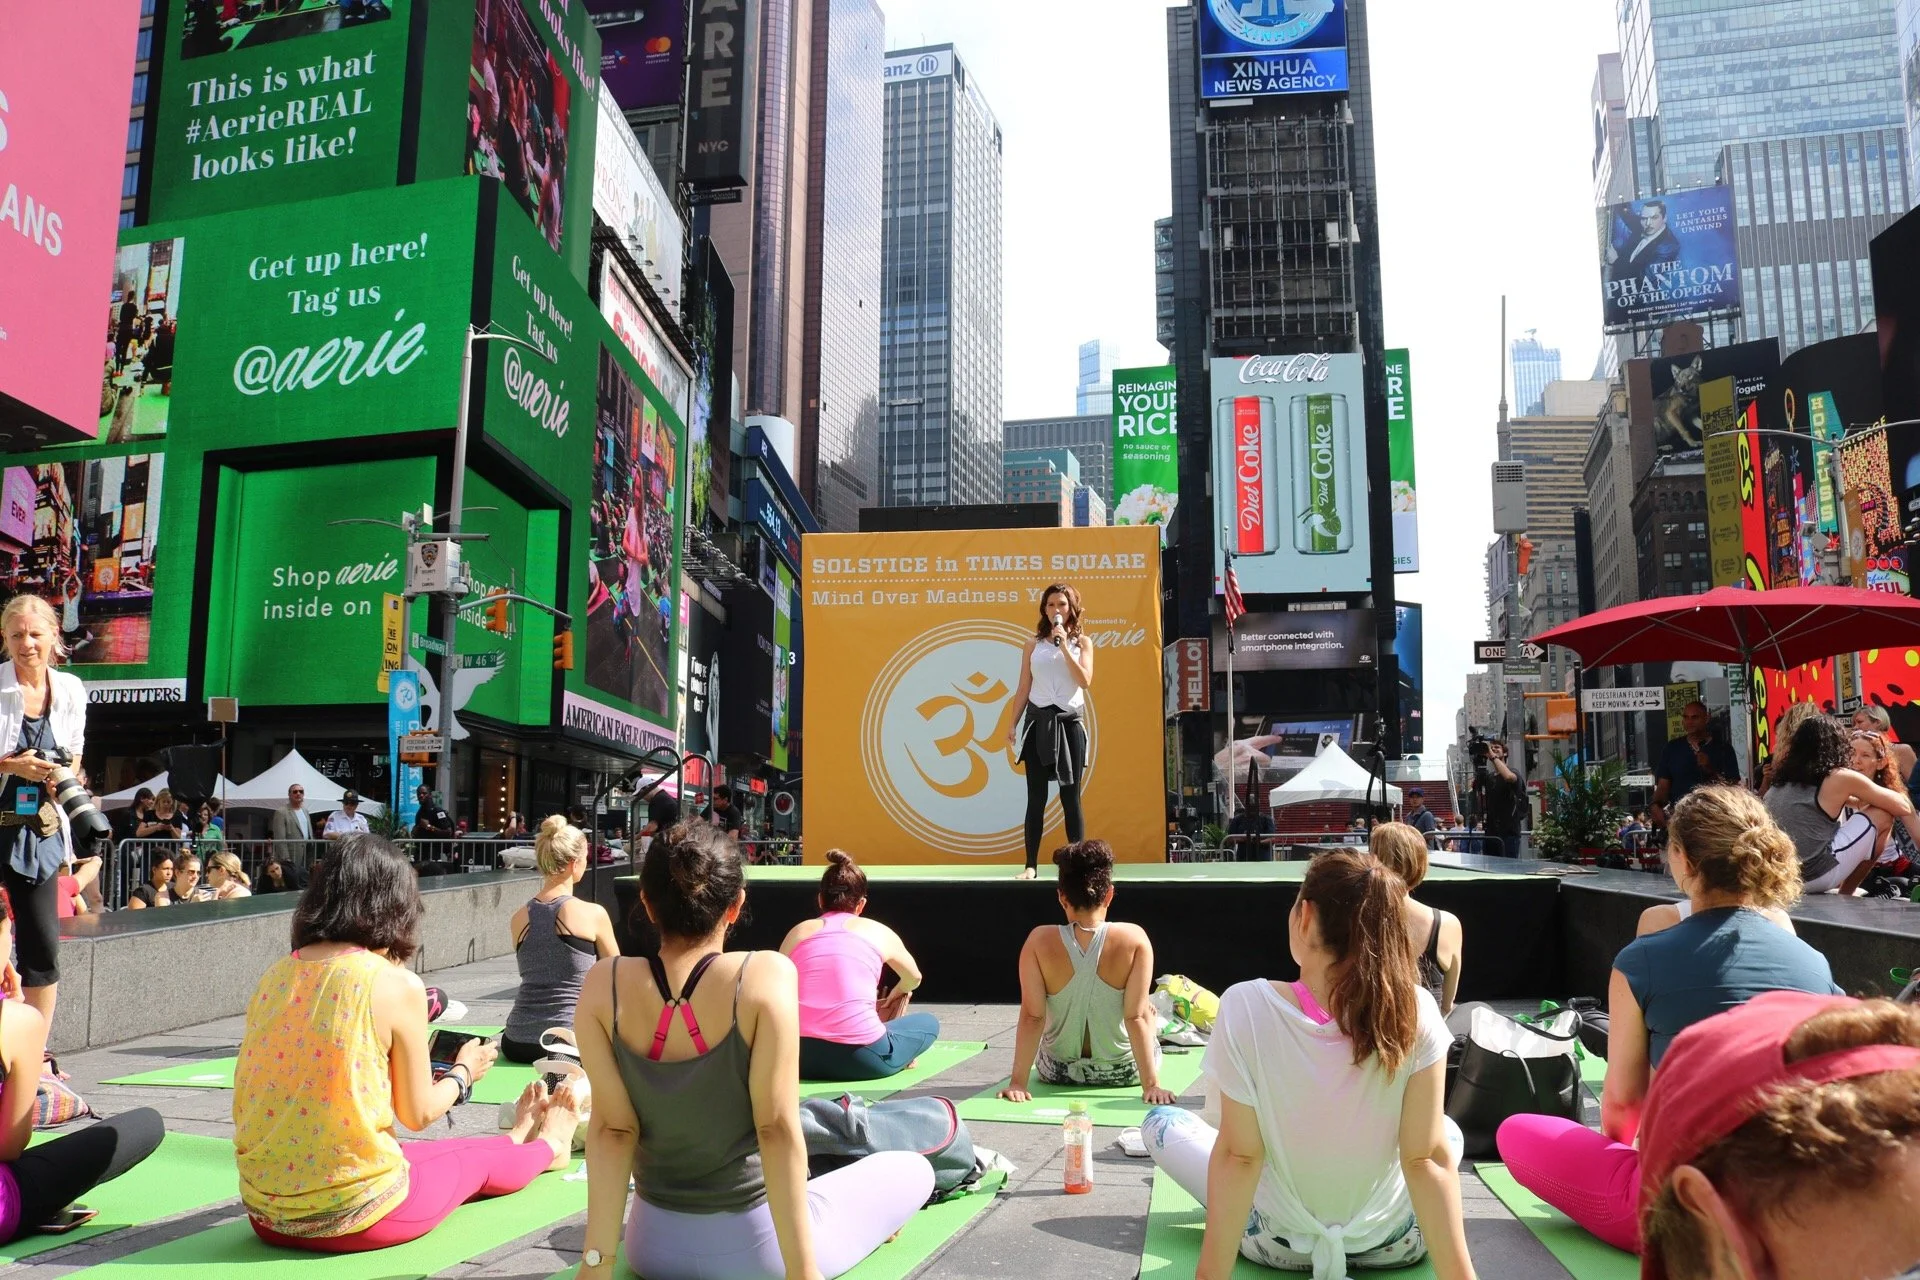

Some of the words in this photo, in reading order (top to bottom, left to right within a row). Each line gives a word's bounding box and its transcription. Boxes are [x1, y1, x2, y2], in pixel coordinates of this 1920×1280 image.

[187, 79, 252, 108] This
[262, 67, 288, 95] is
[297, 49, 378, 87] what
[572, 42, 595, 101] like!
[1232, 59, 1317, 79] XINHUA
[1214, 79, 1263, 93] NEWS
[1266, 74, 1337, 90] AGENCY
[185, 88, 373, 145] #AerieREAL
[191, 147, 275, 182] looks
[284, 126, 357, 166] like!
[698, 140, 729, 154] NYC
[1675, 213, 1728, 228] FANTASIES
[1676, 211, 1696, 220] LET
[1699, 206, 1726, 216] YOUR
[1681, 222, 1723, 234] UNWIND
[250, 256, 297, 281] Get
[304, 250, 341, 277] up
[350, 232, 428, 266] here!
[1650, 260, 1683, 274] THE
[1604, 262, 1734, 300] PHANTOM
[288, 288, 342, 318] Tag
[348, 285, 382, 306] us
[512, 254, 532, 290] Get
[532, 280, 547, 314] up
[548, 299, 574, 343] here!
[1617, 294, 1637, 308] OF
[1638, 289, 1671, 305] THE
[1672, 283, 1723, 299] OPERA
[526, 310, 545, 355] Tag
[546, 341, 559, 365] us
[233, 308, 427, 396] @aerie
[1238, 352, 1333, 384] Coca-Cola
[503, 345, 571, 439] @aerie
[1122, 450, 1171, 463] seasoning
[1238, 423, 1262, 484] Coke
[1310, 423, 1332, 481] Coke
[1318, 481, 1330, 507] Diet
[1240, 485, 1262, 533] Diet
[273, 567, 331, 591] Shop
[335, 552, 399, 586] aerie
[811, 556, 928, 575] SOLSTICE
[935, 555, 959, 573] in
[965, 555, 1043, 572] TIMES
[1051, 553, 1146, 571] SQUARE
[811, 590, 865, 606] Mind
[871, 589, 918, 606] Over
[925, 587, 1019, 605] Madness
[1025, 586, 1046, 603] Y
[263, 597, 333, 621] inside
[343, 599, 372, 617] on
[1083, 617, 1118, 626] Presented
[1118, 616, 1128, 627] by
[419, 635, 447, 656] Broadway
[1240, 632, 1267, 643] Better
[1268, 631, 1314, 641] connected
[1314, 630, 1335, 640] with
[1240, 642, 1293, 653] smartphone
[1294, 640, 1344, 653] integration.
[464, 655, 473, 667] W
[475, 655, 487, 667] 46
[1485, 647, 1506, 657] ONE
[1521, 647, 1536, 657] AY
[88, 686, 182, 704] OUTFITTERS
[1591, 692, 1627, 700] PEDESTRIAN
[1628, 691, 1644, 699] FLOW
[1645, 690, 1661, 698] ZONE
[1592, 701, 1607, 709] KEEP
[1608, 700, 1630, 709] MOVING
[564, 703, 614, 741] AMERICAN
[614, 719, 639, 749] EAGLE
